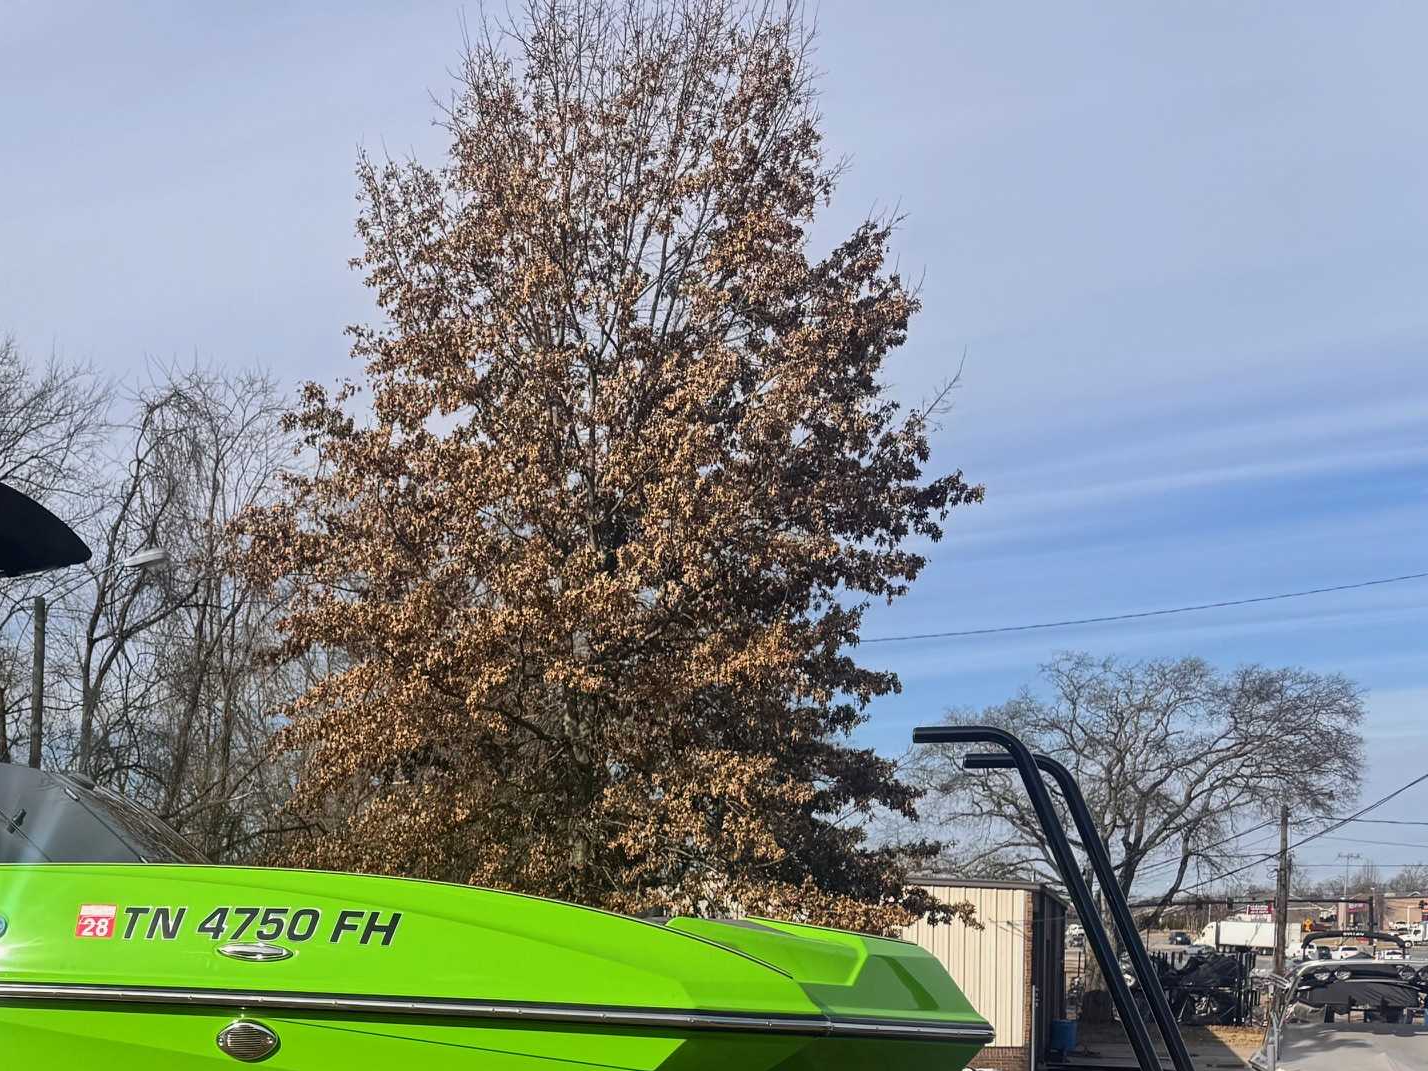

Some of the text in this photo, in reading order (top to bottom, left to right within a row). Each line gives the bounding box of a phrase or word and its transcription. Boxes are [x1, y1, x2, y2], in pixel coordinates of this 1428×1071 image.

[79, 917, 109, 937] 28
[122, 906, 402, 946] TN 4750 FH
